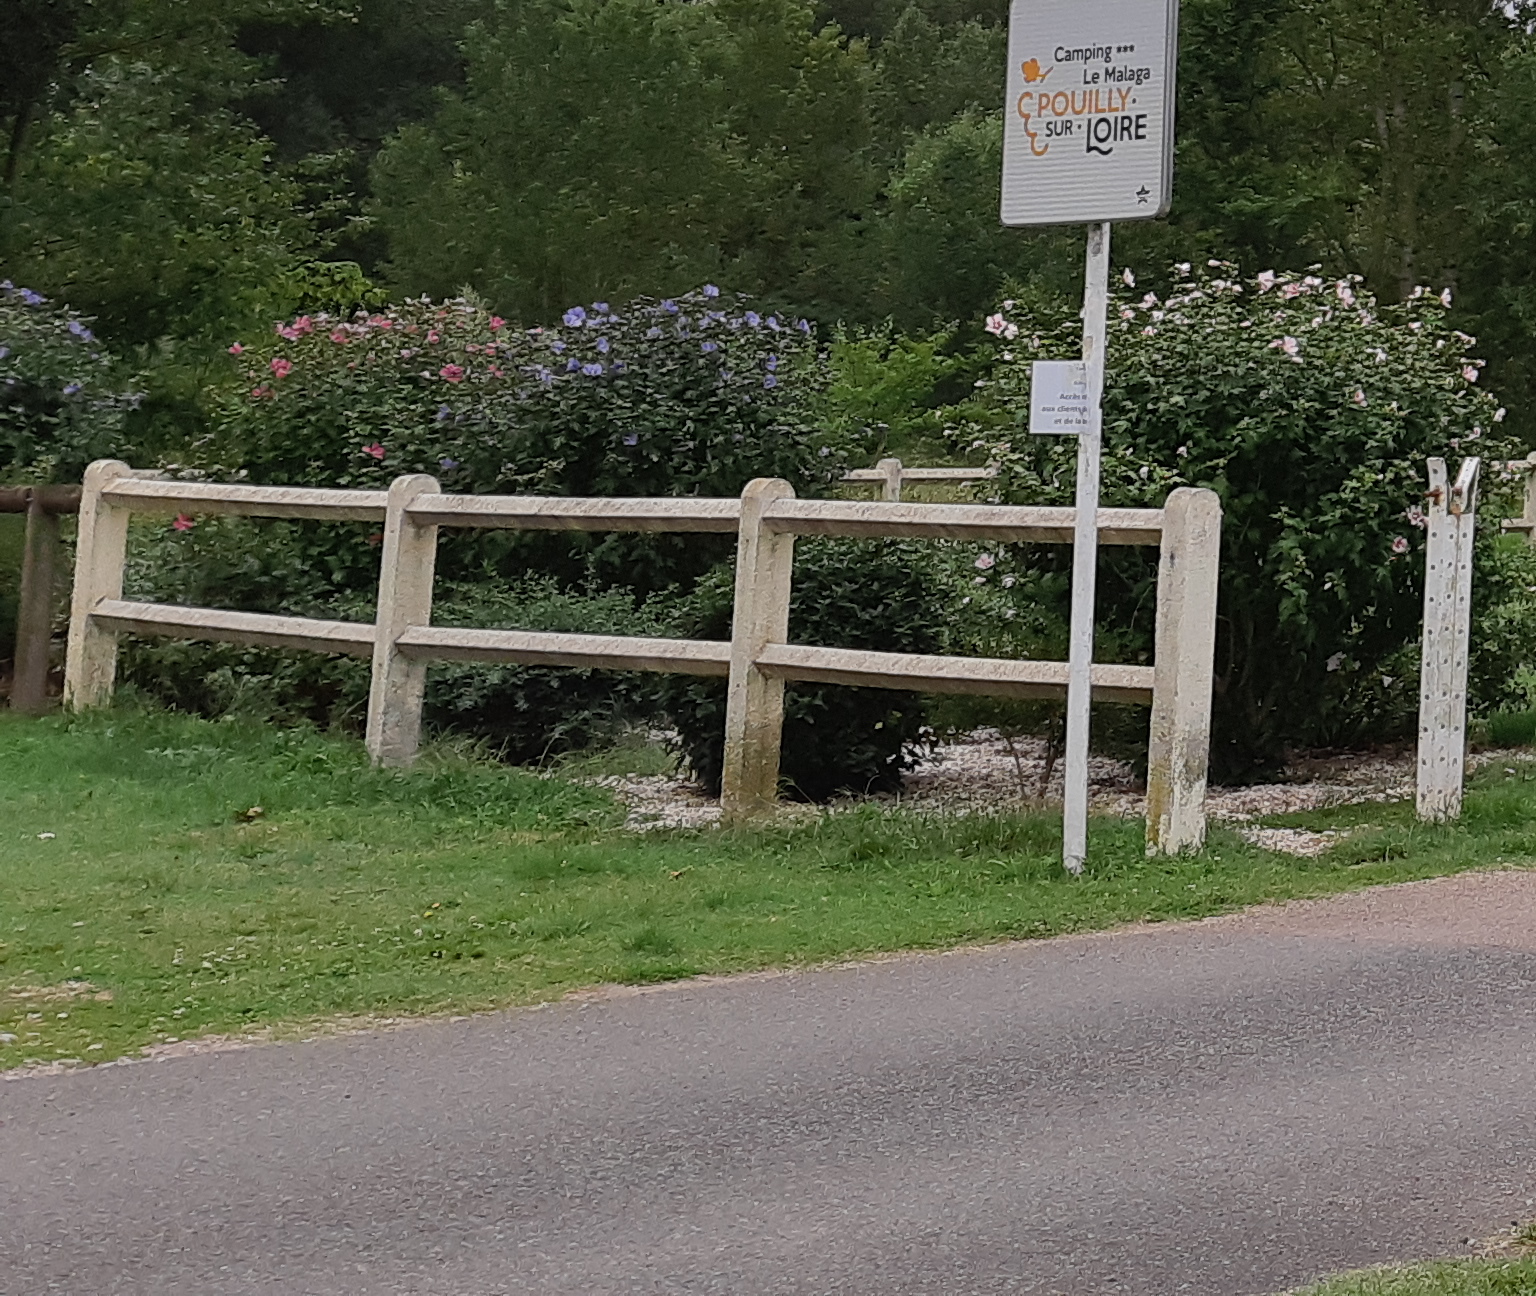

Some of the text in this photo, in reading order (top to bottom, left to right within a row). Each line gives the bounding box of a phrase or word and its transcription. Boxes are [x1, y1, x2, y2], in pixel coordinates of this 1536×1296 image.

[1054, 43, 1112, 65] Camping
[1083, 65, 1150, 85] Le Malaga
[1037, 86, 1132, 118] POUILLY
[1045, 114, 1147, 155] SUR LOIRE
